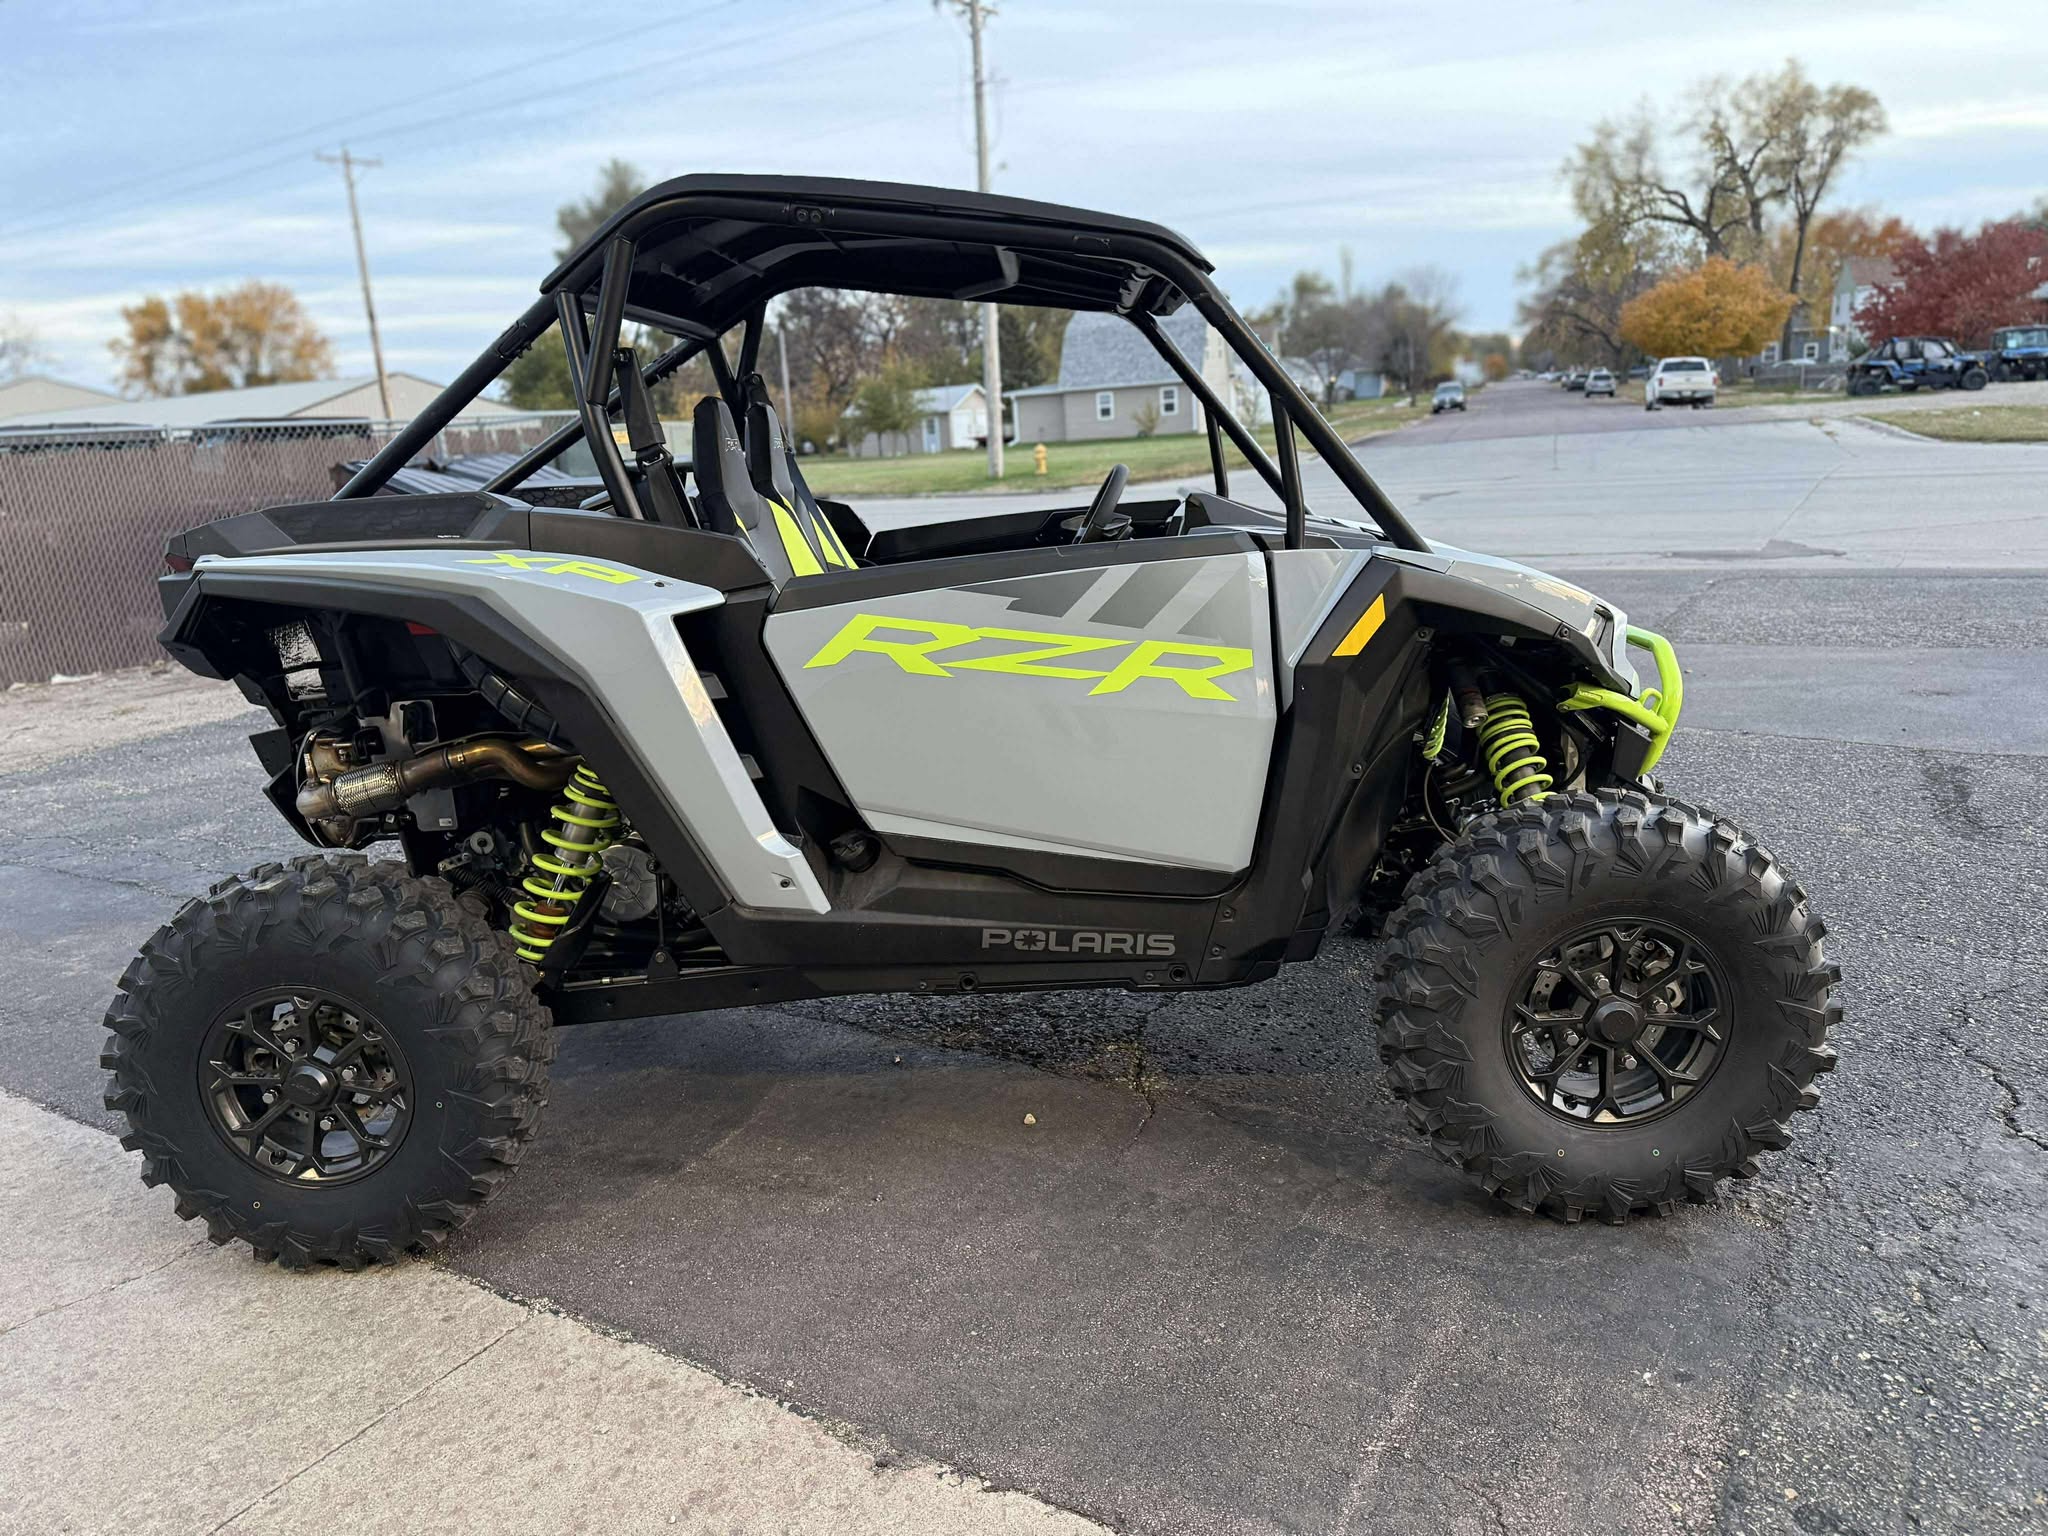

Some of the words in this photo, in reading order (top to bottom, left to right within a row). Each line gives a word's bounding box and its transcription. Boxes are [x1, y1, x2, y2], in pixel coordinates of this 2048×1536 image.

[456, 552, 642, 585] XP
[802, 613, 1254, 702] RZR
[981, 928, 1176, 957] POLARIS
